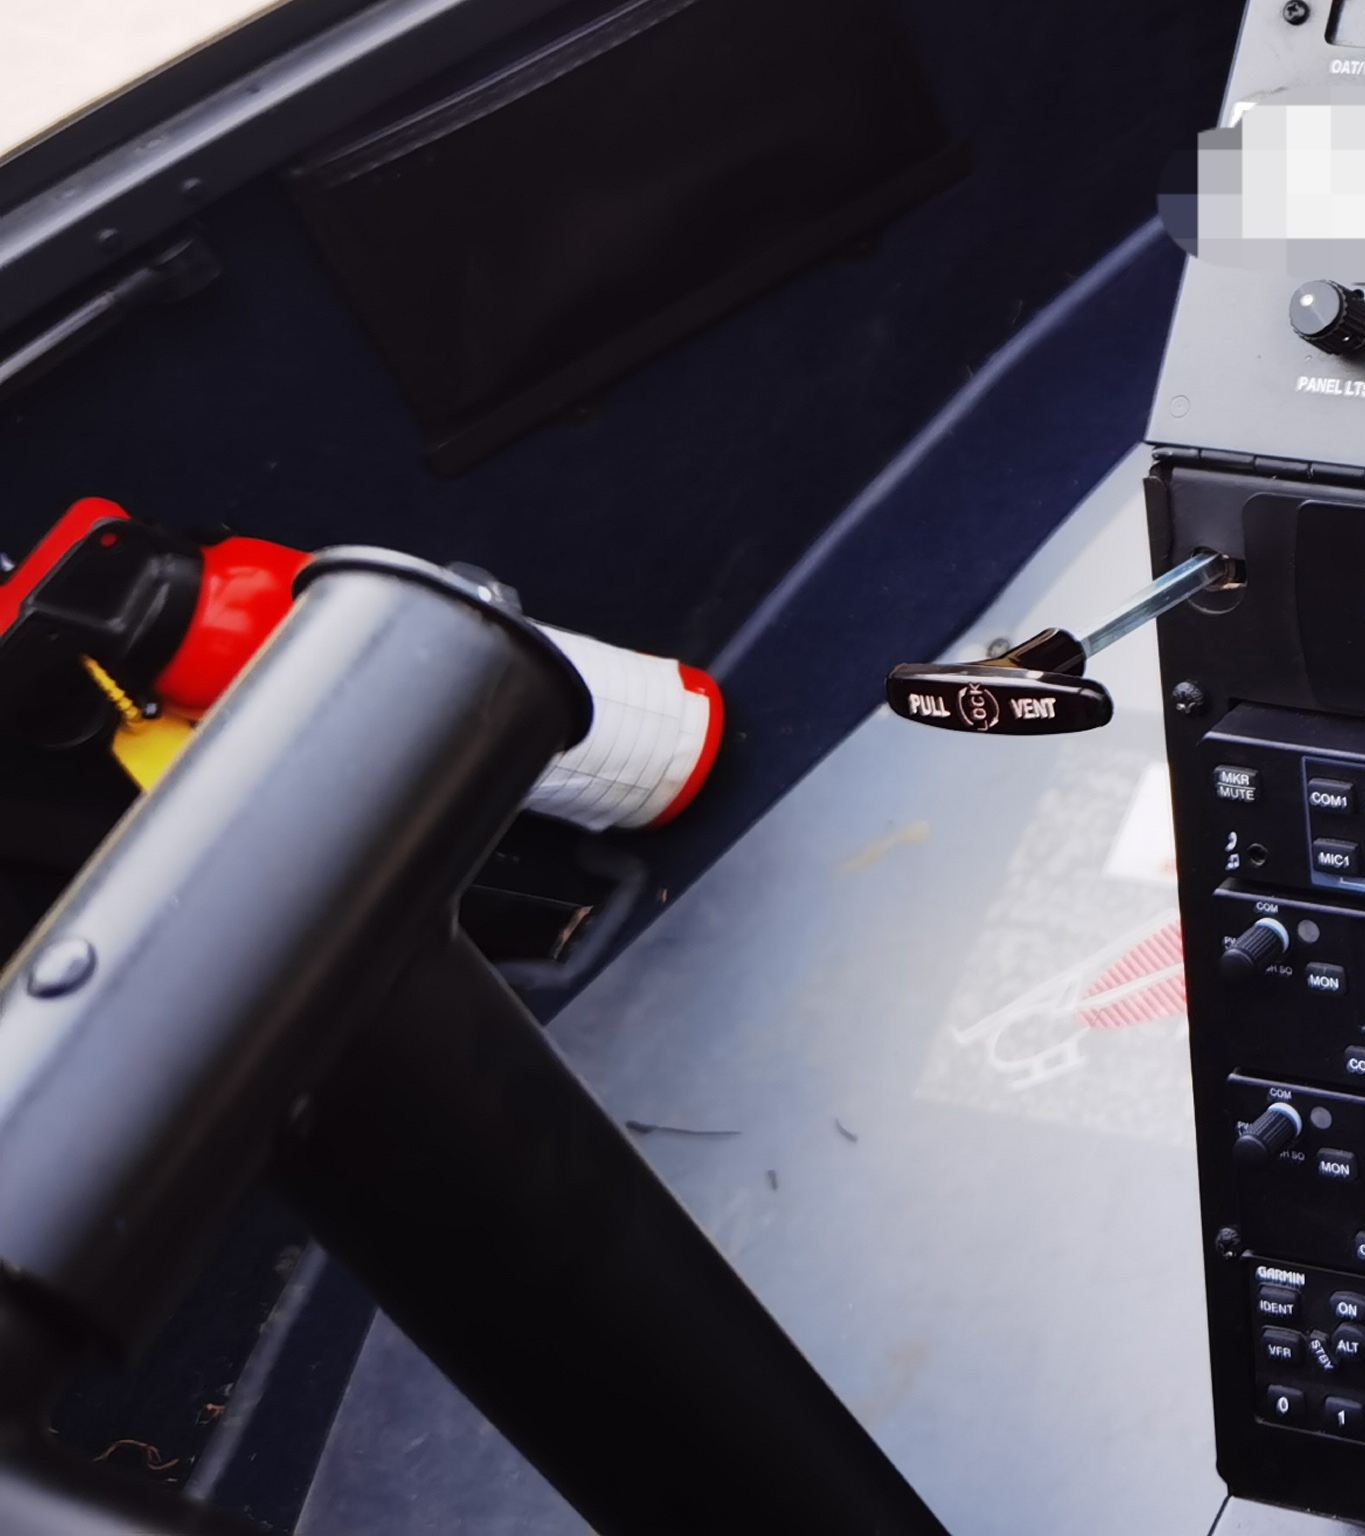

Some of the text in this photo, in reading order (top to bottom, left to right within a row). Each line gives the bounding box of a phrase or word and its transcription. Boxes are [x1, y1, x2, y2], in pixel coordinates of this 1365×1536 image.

[1297, 376, 1343, 395] PANEL
[909, 694, 1056, 719] PULL VENT
[1311, 792, 1347, 807] COM1
[1319, 852, 1349, 866] MIC1
[1309, 974, 1338, 989] MON
